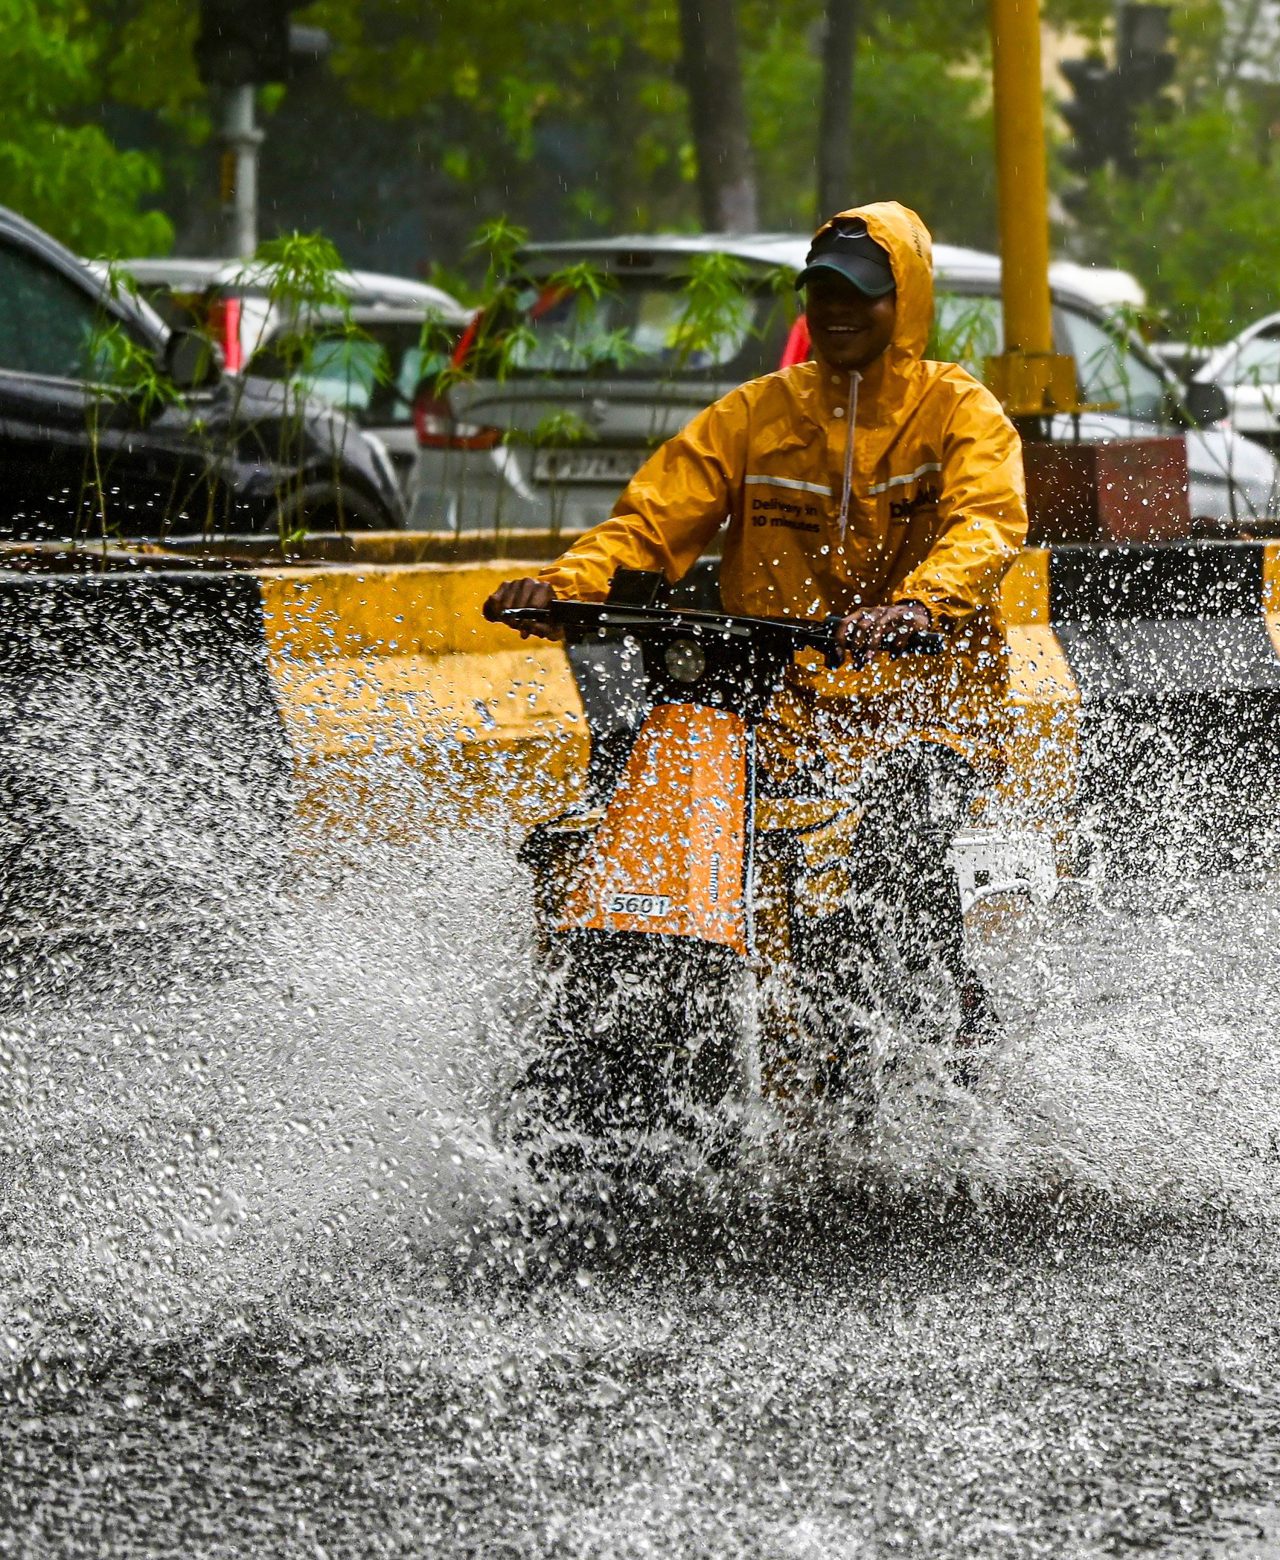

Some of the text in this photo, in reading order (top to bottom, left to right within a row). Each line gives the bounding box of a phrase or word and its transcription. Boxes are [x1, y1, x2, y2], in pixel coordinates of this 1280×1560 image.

[752, 498, 801, 517] Delivery
[752, 515, 820, 533] 10 minutes
[611, 896, 665, 915] 5601
